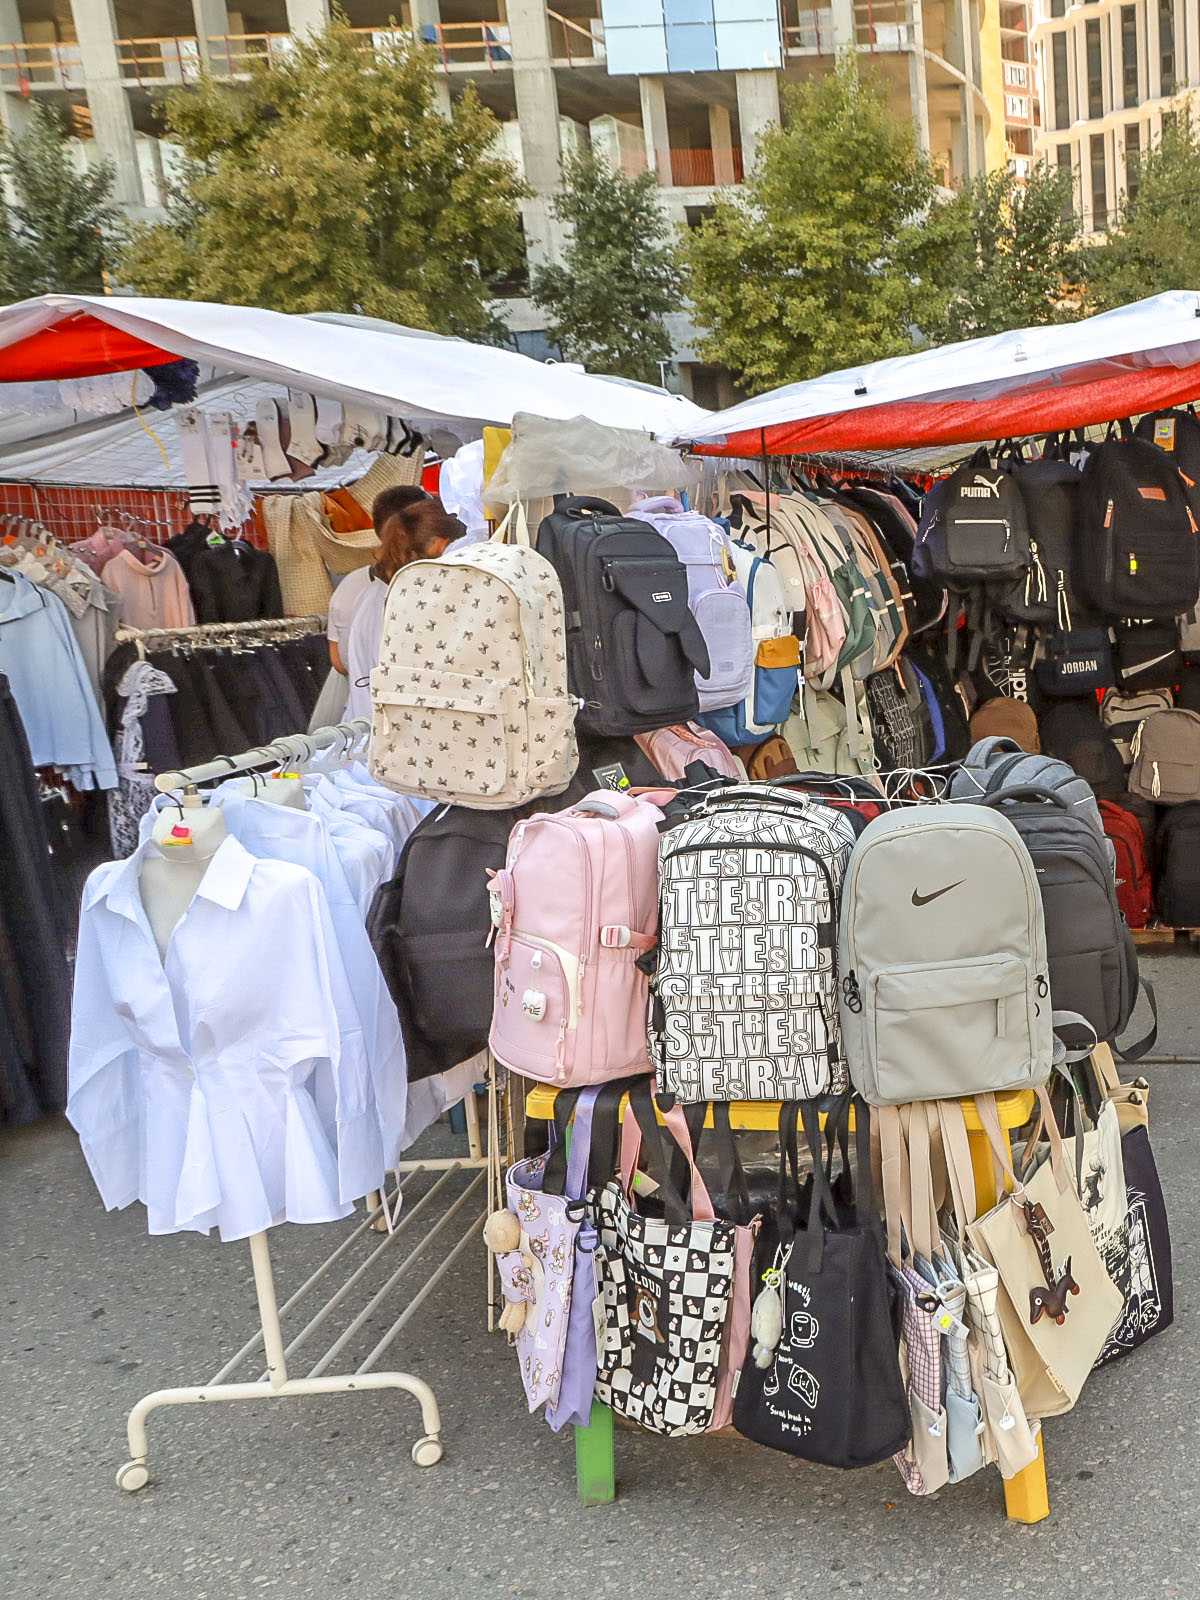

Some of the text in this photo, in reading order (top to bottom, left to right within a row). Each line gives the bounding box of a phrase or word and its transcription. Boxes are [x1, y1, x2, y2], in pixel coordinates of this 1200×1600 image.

[960, 486, 991, 498] PUMA
[1061, 660, 1098, 675] JORDAN
[627, 1267, 662, 1299] CLOUD
[788, 1279, 812, 1308] weetly
